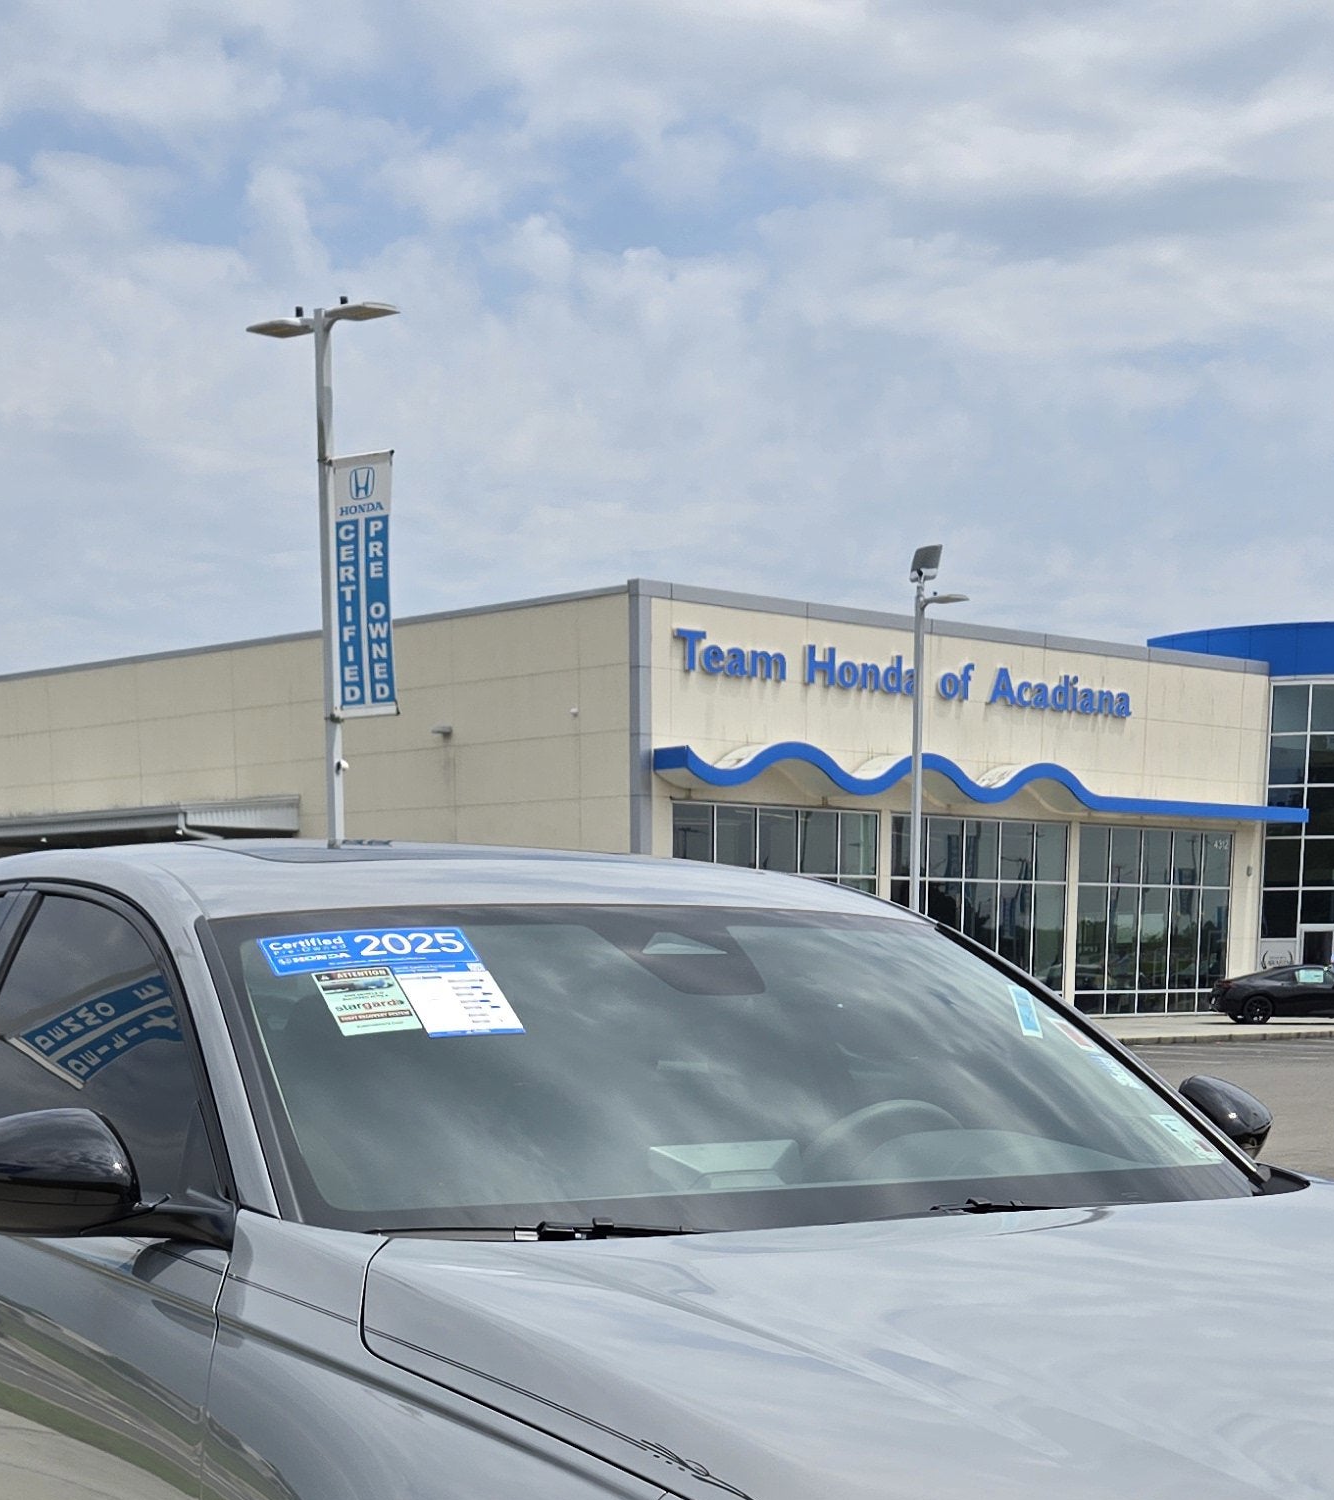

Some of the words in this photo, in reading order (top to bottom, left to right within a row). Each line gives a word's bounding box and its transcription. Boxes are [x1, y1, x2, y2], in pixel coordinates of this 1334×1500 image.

[339, 501, 384, 517] HONDA
[368, 521, 384, 579] PRE
[338, 524, 362, 703] CERTIFIED
[368, 602, 390, 700] OWNED
[674, 628, 787, 682] Team
[806, 644, 916, 697] Honda
[939, 664, 975, 701] of
[988, 667, 1133, 720] Acadiana
[268, 935, 345, 952] Certified
[353, 932, 465, 957] 2025
[293, 951, 351, 964] HONDA
[335, 967, 387, 980] ATTENTION
